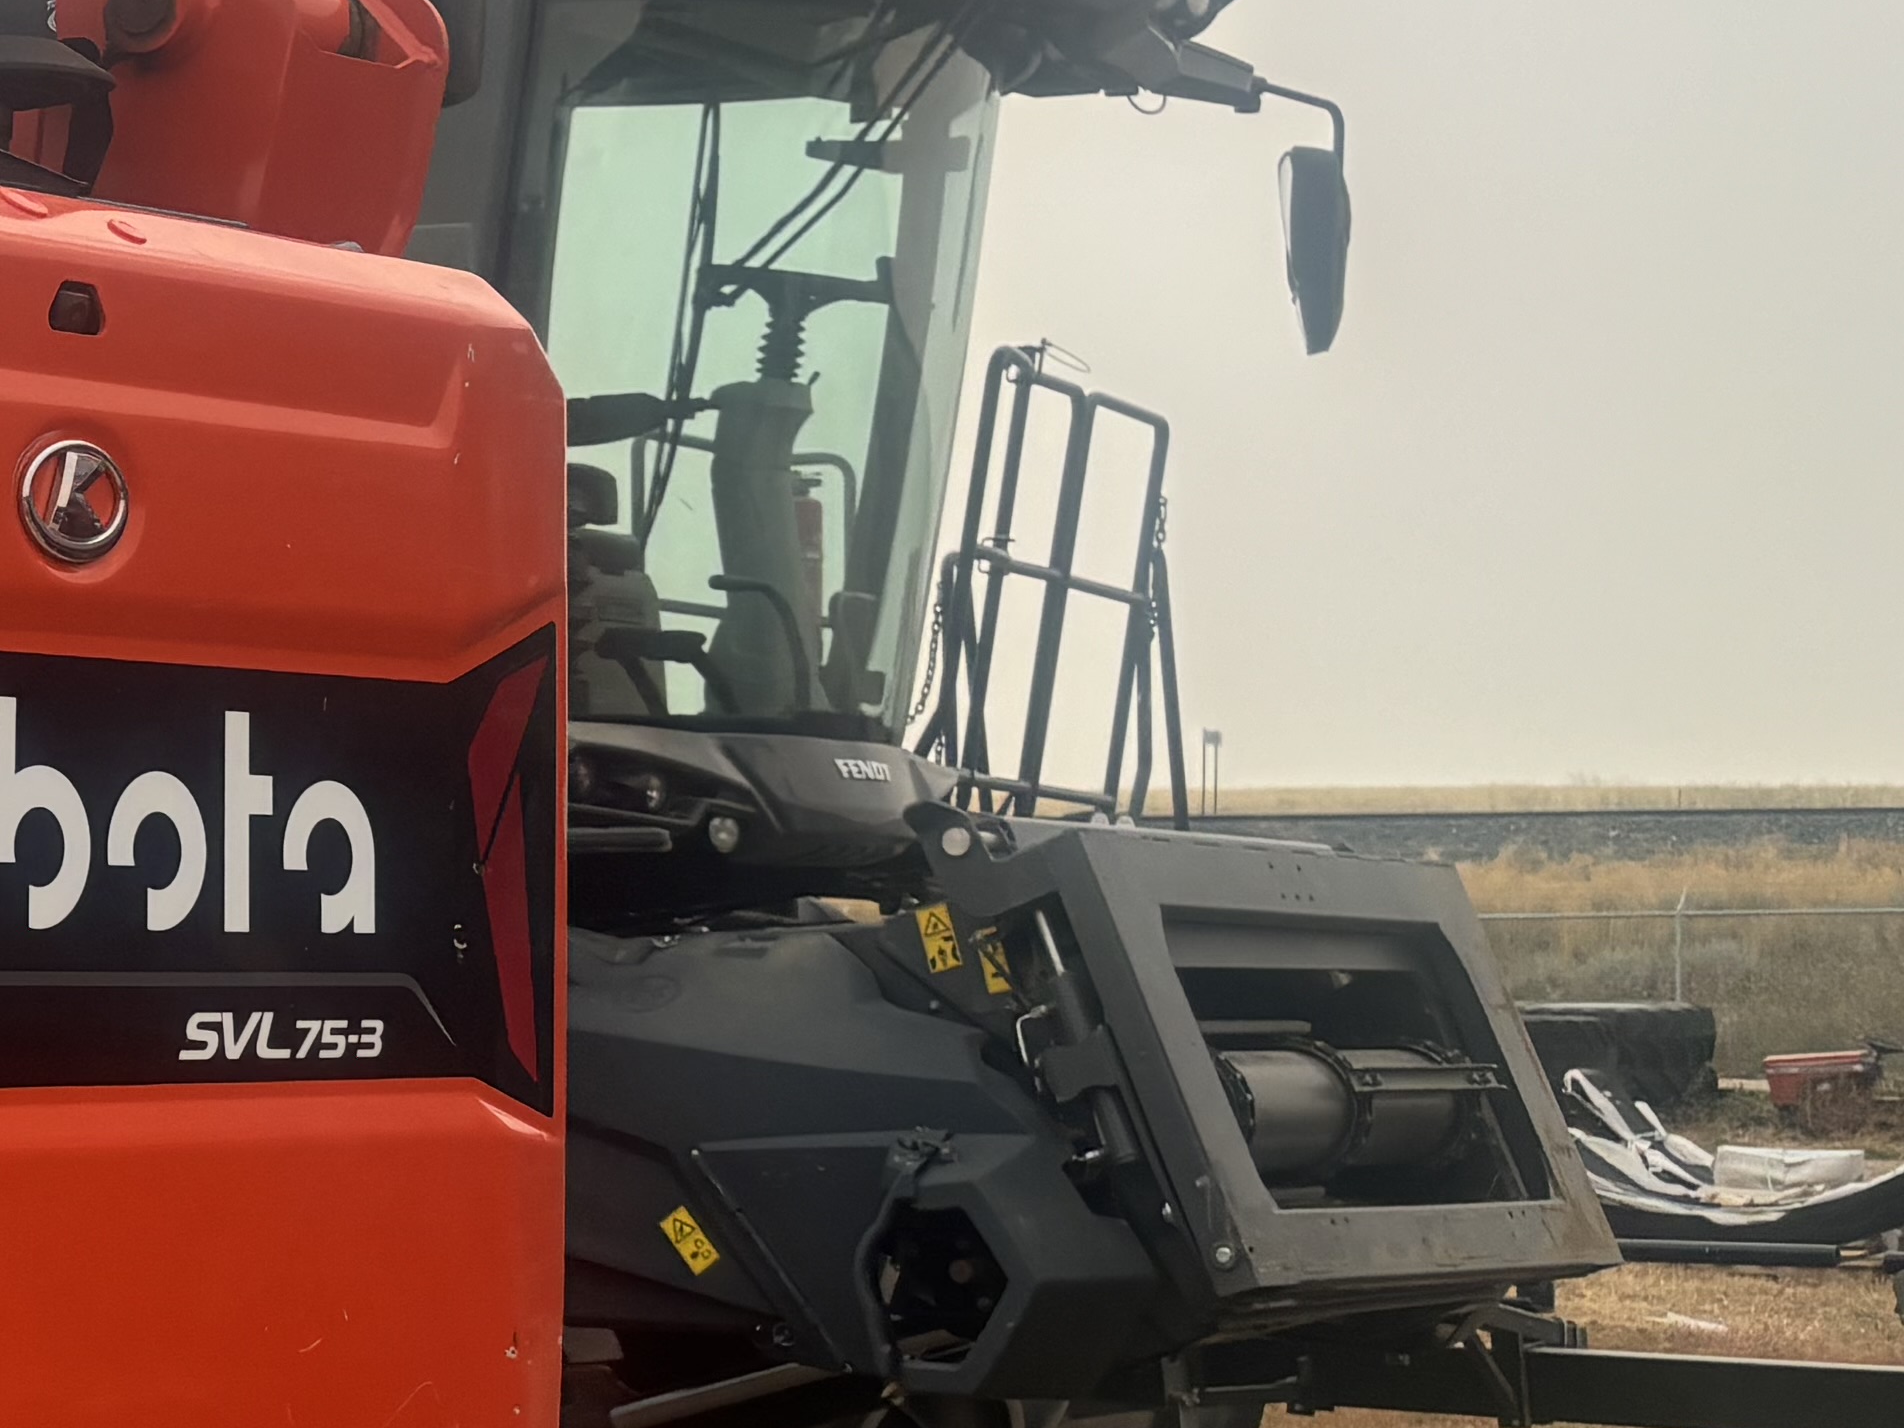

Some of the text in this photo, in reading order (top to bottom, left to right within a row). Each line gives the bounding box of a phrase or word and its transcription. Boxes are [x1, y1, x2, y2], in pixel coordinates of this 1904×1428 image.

[833, 758, 891, 782] FENDT
[178, 1011, 385, 1060] SVL 75-3
